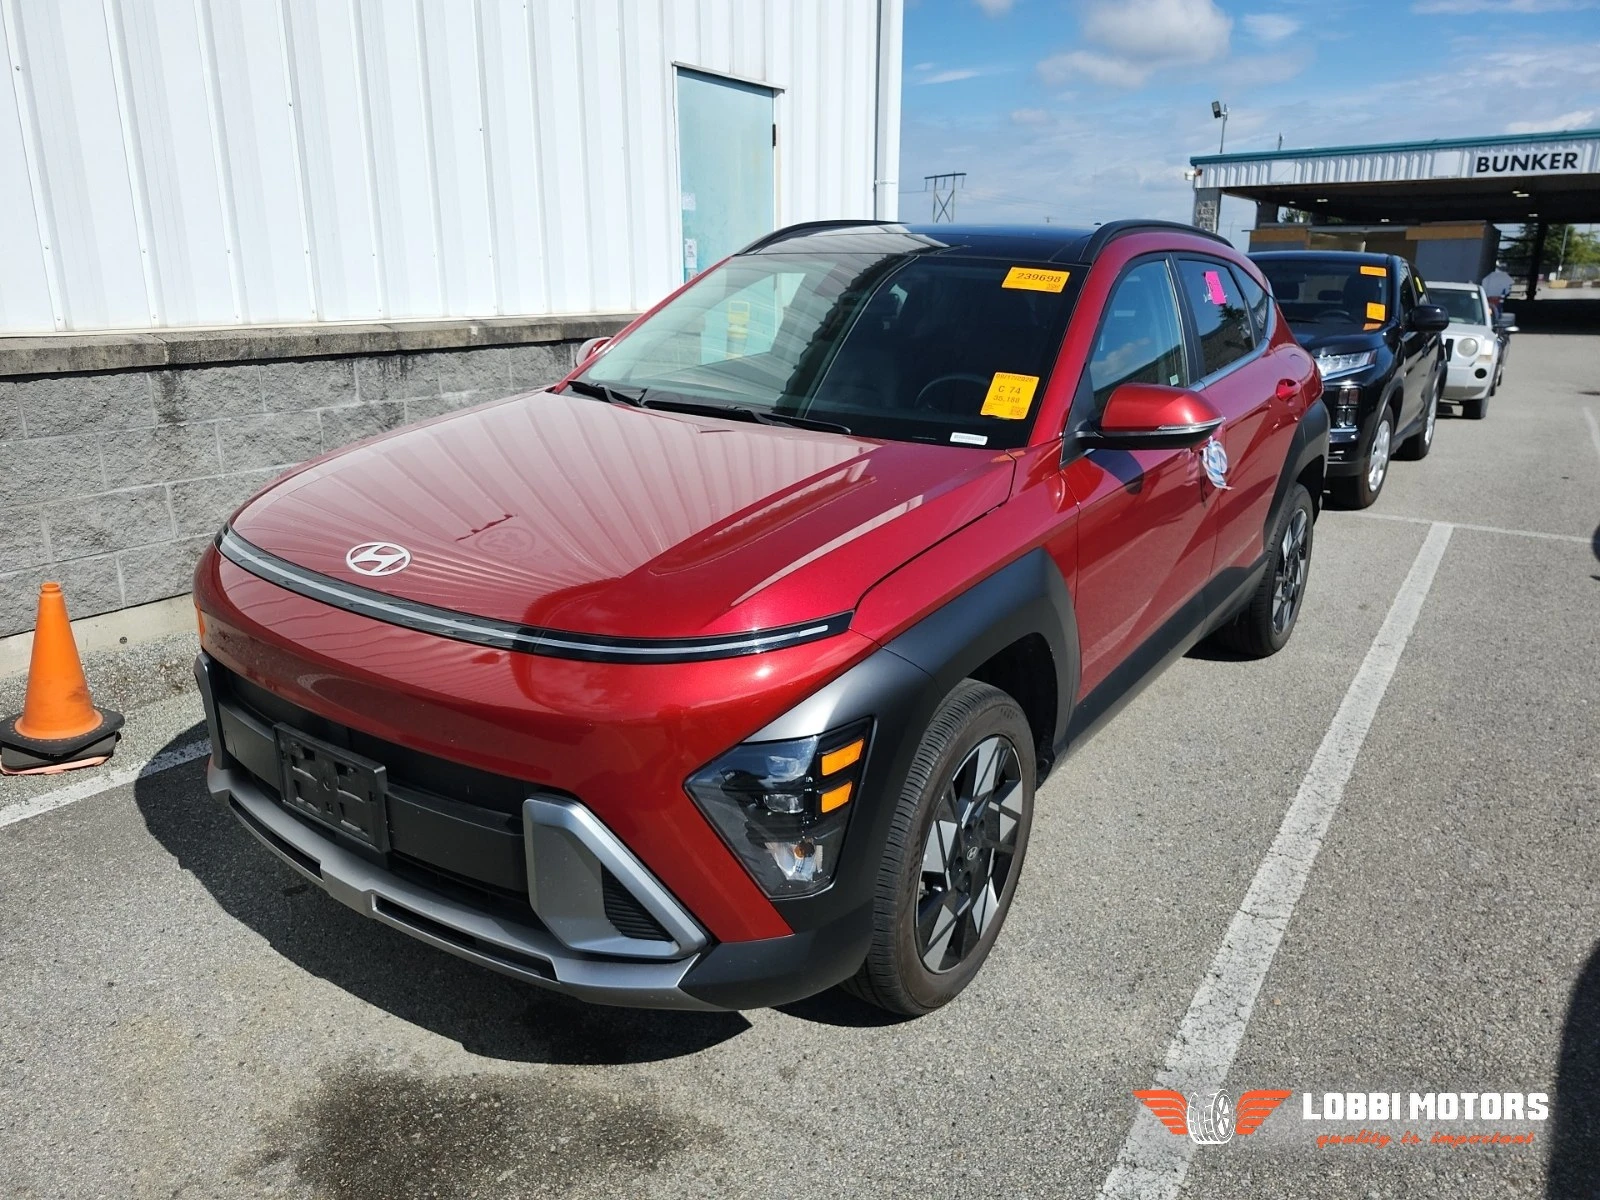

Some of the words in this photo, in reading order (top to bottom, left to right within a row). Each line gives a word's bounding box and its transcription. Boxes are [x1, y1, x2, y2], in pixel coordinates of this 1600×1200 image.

[1476, 152, 1578, 173] BUNKER
[1016, 272, 1062, 283] 239698
[1009, 386, 1021, 394] 74
